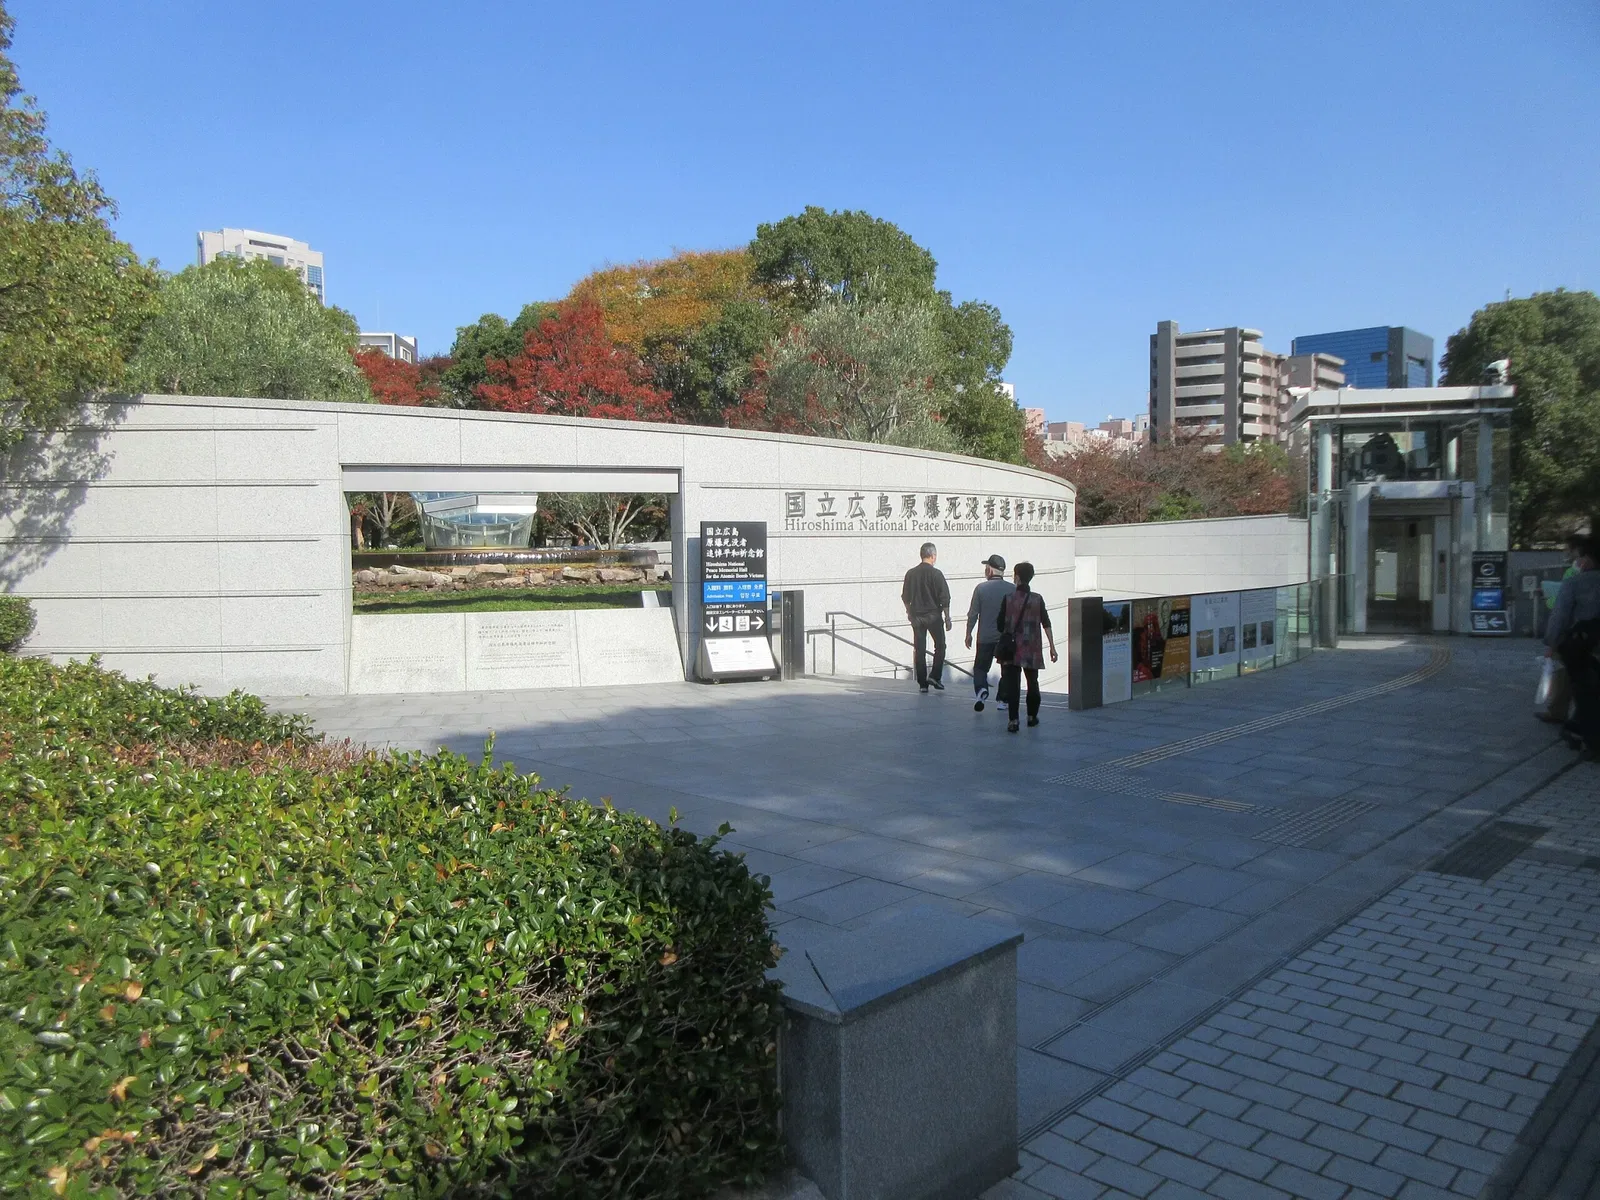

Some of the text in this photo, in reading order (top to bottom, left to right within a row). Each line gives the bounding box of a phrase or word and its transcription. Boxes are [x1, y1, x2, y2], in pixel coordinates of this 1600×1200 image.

[785, 518, 854, 531] Hiroshima
[859, 519, 907, 531] National
[912, 520, 940, 532] Peace
[943, 520, 982, 532] Memorial
[985, 520, 1001, 532] Hall
[1003, 521, 1012, 532] for
[1014, 521, 1024, 532] the
[706, 527, 739, 536] 国立広島
[705, 537, 748, 547] 原爆死没者
[706, 548, 764, 558] 追悼平和祈念館
